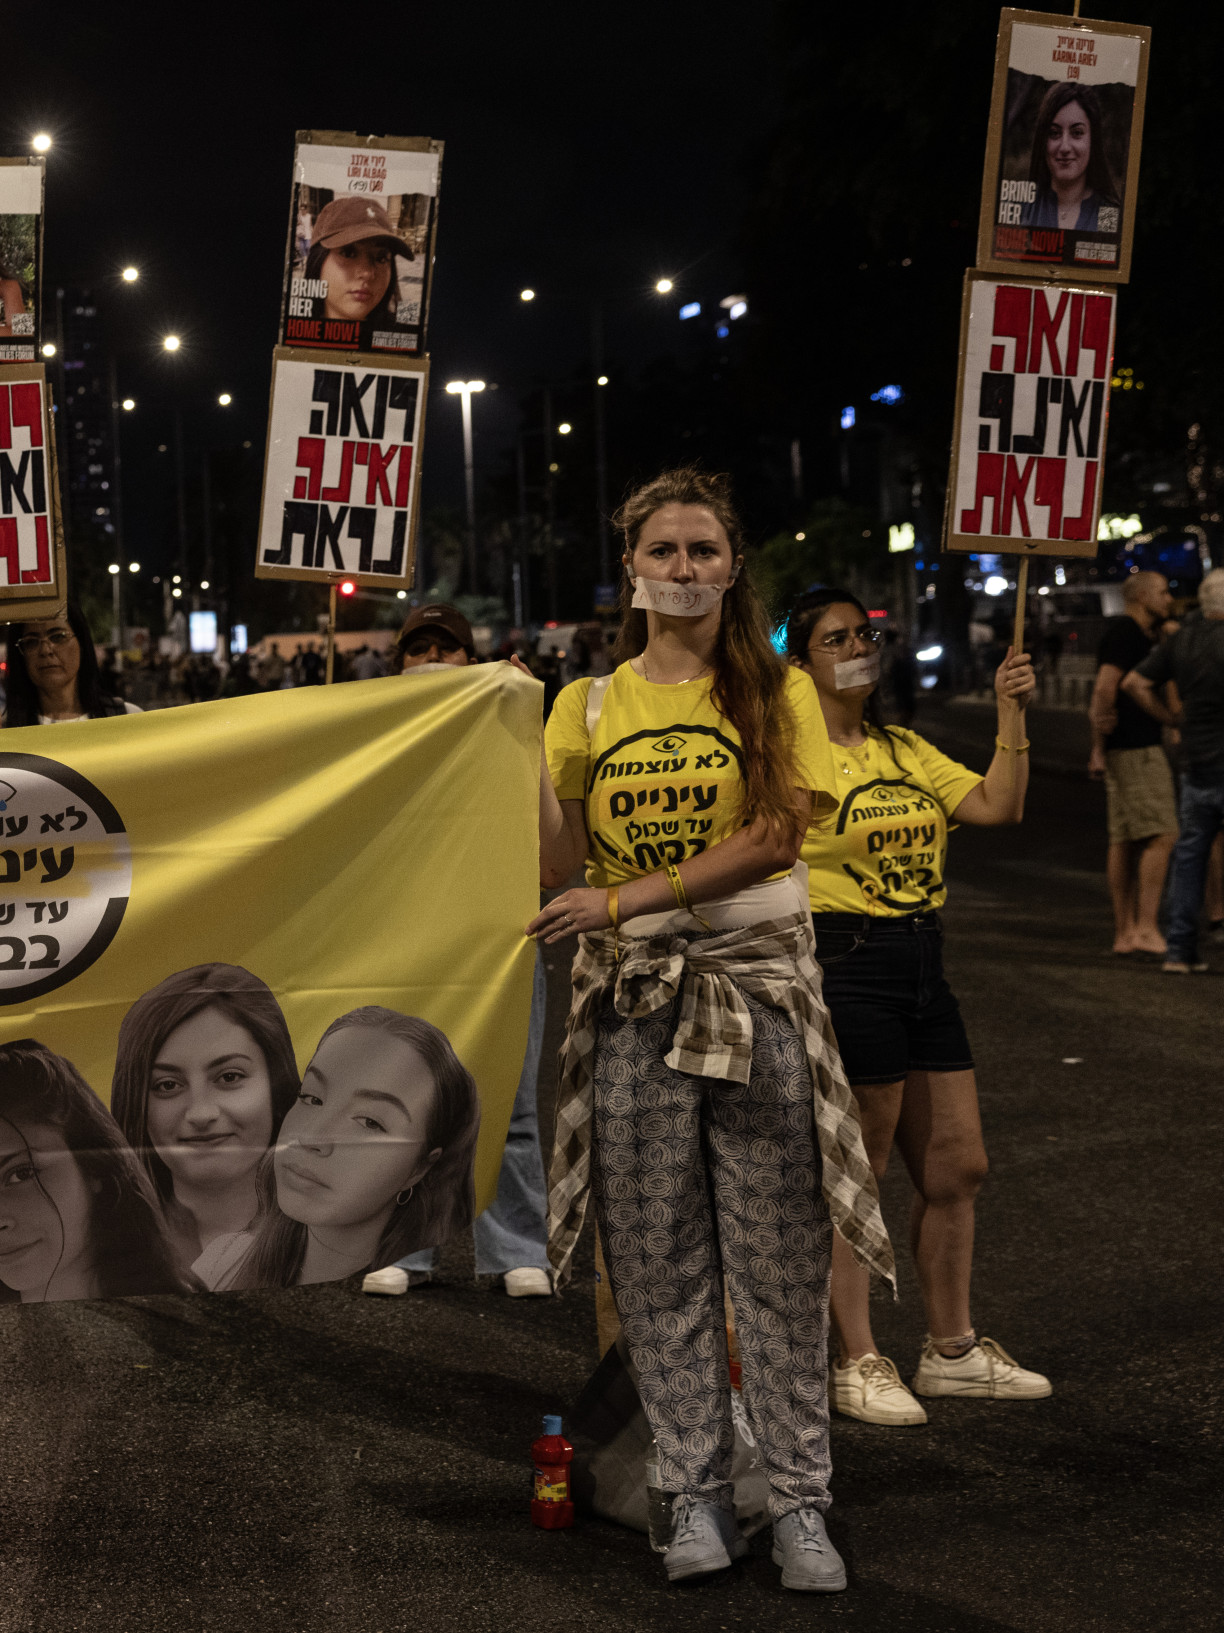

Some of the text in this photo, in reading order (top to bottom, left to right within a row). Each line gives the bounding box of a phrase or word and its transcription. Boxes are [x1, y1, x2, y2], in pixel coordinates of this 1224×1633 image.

[1052, 49, 1098, 66] KARINA ARIEV
[347, 166, 387, 180] LIRI ALBAG
[348, 180, 368, 192] (19)
[1000, 179, 1036, 203] BRING
[998, 202, 1022, 225] HER
[995, 226, 1028, 250] HOME
[1031, 229, 1064, 254] NOW!
[291, 277, 329, 298] BRING
[289, 297, 313, 317] HER
[287, 319, 322, 339] HOME
[324, 321, 360, 342] NOW!
[989, 285, 1112, 379] רואה
[309, 369, 419, 442] רואה
[978, 372, 1105, 458] ואינה
[293, 436, 413, 508] ואינה
[961, 452, 1098, 541] נראת
[263, 500, 408, 575] נראת
[599, 749, 730, 781] לא עוצמות
[609, 784, 718, 819] עיניים
[851, 804, 910, 823] עוצמות
[40, 805, 88, 834] לא
[625, 818, 713, 844] עד שכולן
[867, 823, 936, 854] עיניים
[917, 852, 935, 865] עד
[25, 900, 69, 925] עד
